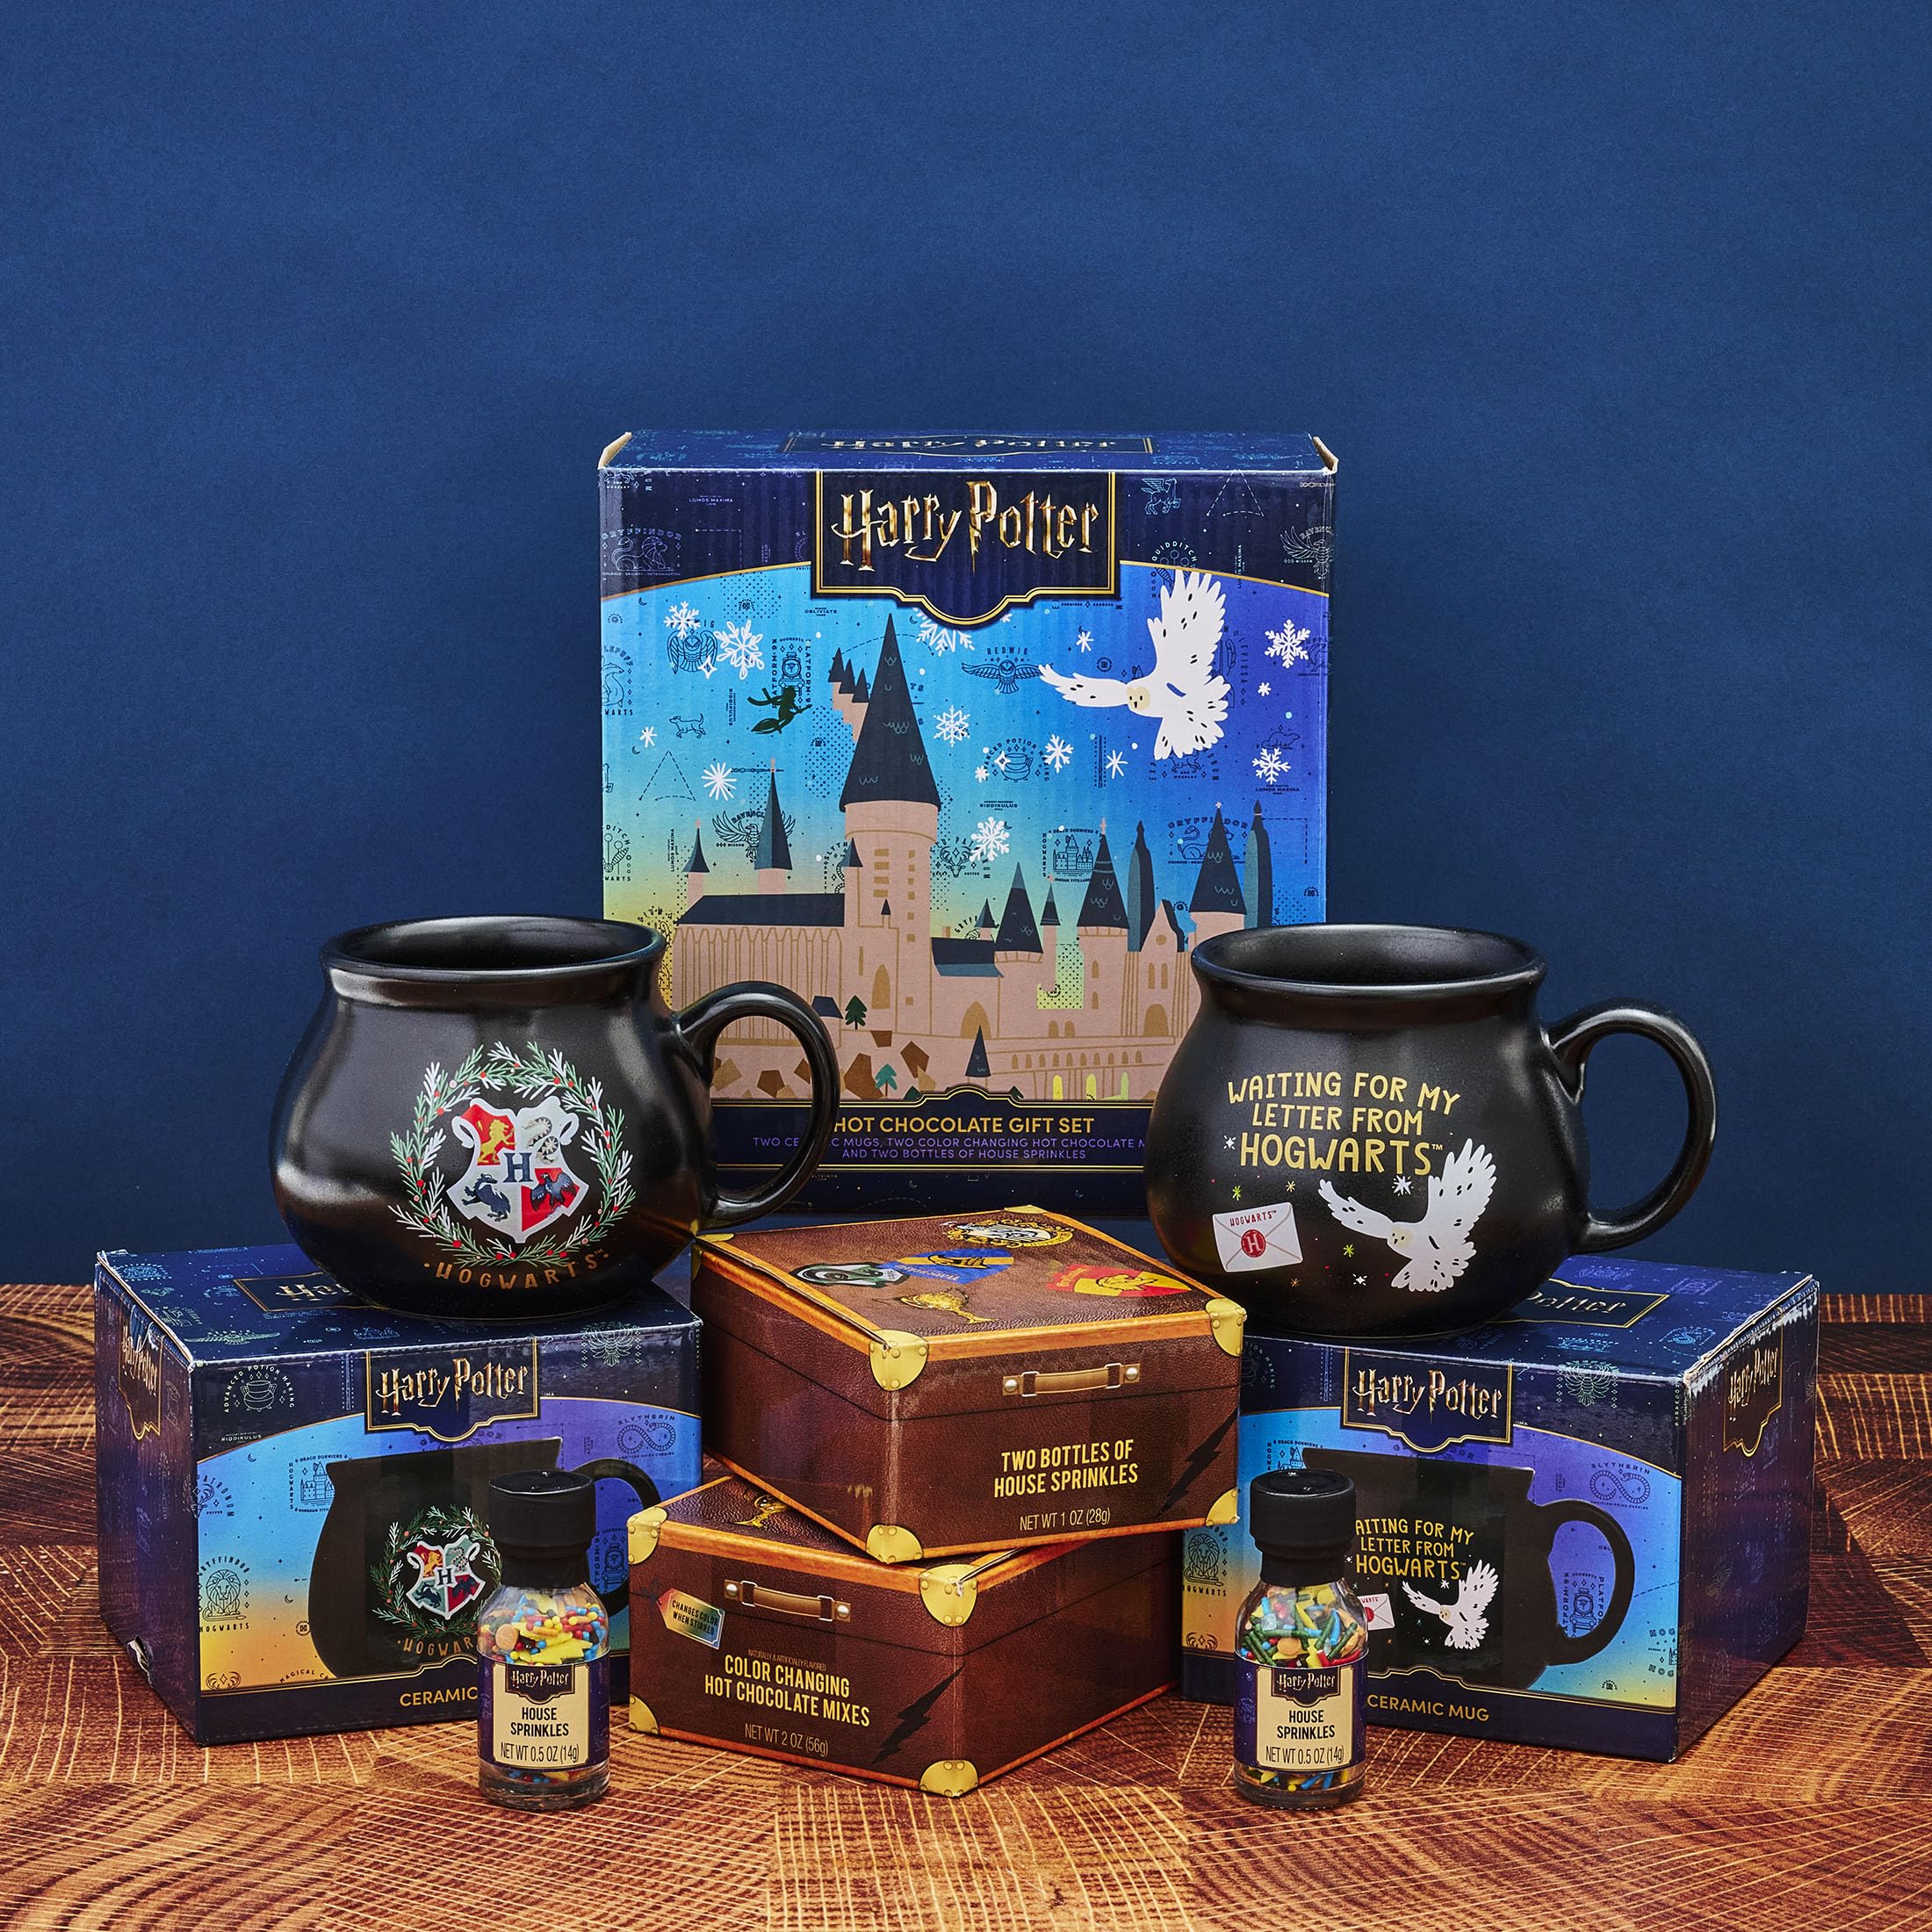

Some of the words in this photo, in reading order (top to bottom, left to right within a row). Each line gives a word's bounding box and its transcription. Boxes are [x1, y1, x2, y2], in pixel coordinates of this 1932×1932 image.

[831, 488, 962, 572] Harry
[966, 479, 1099, 573] Potter
[1151, 541, 1199, 562] QUIDDITCH
[986, 646, 1028, 655] HEDWIG
[1006, 738, 1037, 750] POTION
[1168, 817, 1248, 830] GRYFFIDOR
[1228, 1071, 1342, 1104] WAITING
[1353, 1072, 1408, 1102] FOR
[1417, 1083, 1460, 1115] MY
[833, 1116, 874, 1134] HOT
[880, 1117, 1006, 1134] CHOCOLATE
[1009, 1117, 1054, 1134] GIFT
[1058, 1117, 1095, 1134] SET
[1251, 1103, 1342, 1130] LETTER
[1352, 1107, 1423, 1136] FROM
[753, 1137, 781, 1148] TWO
[843, 1138, 881, 1150] MUGS,
[887, 1137, 914, 1148] TWO
[919, 1137, 960, 1149] COLOR
[963, 1137, 1028, 1149] CHANGING
[1033, 1137, 1055, 1149] HOT
[1058, 1137, 1135, 1150] CHOCOLATE
[842, 1149, 868, 1159] AND
[872, 1149, 898, 1159] TWO
[903, 1149, 955, 1159] BOTTLES
[958, 1149, 976, 1159] OF
[978, 1149, 1020, 1159] HOUSE
[1023, 1149, 1086, 1160] SPRINKLES
[502, 1152, 534, 1183] H
[223, 1371, 245, 1413] ADVANCED
[247, 1365, 281, 1375] POTION
[282, 1375, 295, 1409] MAKING
[375, 1366, 451, 1417] Harry
[451, 1356, 529, 1412] Potter
[1352, 1368, 1425, 1417] Harry
[1427, 1369, 1503, 1425] Potter
[617, 1414, 675, 1426] SLYTHERIN
[1001, 1447, 1036, 1473] TWO
[1040, 1441, 1109, 1468] BOTTLES
[1114, 1438, 1134, 1460] OF
[1591, 1462, 1650, 1475] SLYTHERIN
[993, 1474, 1046, 1498] HOUSE
[1050, 1463, 1138, 1492] SPRINKLES
[1020, 1513, 1040, 1532] NET
[1042, 1511, 1057, 1529] WT
[1060, 1510, 1066, 1525] 1
[1069, 1509, 1084, 1525] OZ
[1085, 1506, 1111, 1528] (28g)
[1355, 1517, 1409, 1537] AITING
[1416, 1519, 1442, 1540] FOR
[1451, 1525, 1474, 1546] MY
[1360, 1536, 1411, 1554] LETTER
[1416, 1539, 1455, 1559] FROM
[436, 1568, 452, 1586] H
[672, 1599, 700, 1619] CHANGES
[699, 1610, 718, 1626] COLOR
[672, 1610, 690, 1626] WHEN
[402, 1636, 473, 1657] HOGWAR
[747, 1648, 772, 1662] NATURALLY
[279, 1669, 315, 1683] MAGICAL
[510, 1669, 539, 1689] Harry
[539, 1669, 569, 1686] Potter
[724, 1654, 771, 1683] COLOR
[775, 1664, 850, 1698] CHANGING
[1276, 1674, 1308, 1692] Harry
[1306, 1673, 1336, 1690] Potter
[399, 1687, 479, 1707] CERAMIC
[704, 1675, 732, 1696] HOT
[736, 1681, 818, 1716] CHOCOLATE
[823, 1699, 870, 1727] MIXES
[1366, 1693, 1445, 1717] CERAMIC
[1448, 1703, 1489, 1722] MUG
[521, 1706, 558, 1721] HOUSE
[1288, 1709, 1324, 1724] HOUSE
[510, 1722, 570, 1737] SPRINKLES
[745, 1723, 761, 1741] NET
[764, 1727, 780, 1743] WT
[781, 1730, 788, 1745] 2
[789, 1733, 804, 1749] OZ
[805, 1735, 828, 1757] (56g)
[1276, 1725, 1336, 1740] SPRINKLES
[501, 1741, 515, 1760] NET
[515, 1743, 529, 1761] WT
[530, 1745, 544, 1763] 0.5
[546, 1744, 559, 1763] OZ
[559, 1743, 580, 1763] (14g)
[1265, 1745, 1281, 1763] NET
[1281, 1747, 1297, 1763] WT
[1297, 1748, 1312, 1764] 0.5
[1313, 1747, 1326, 1764] OZ
[1326, 1744, 1344, 1767] (14g)
